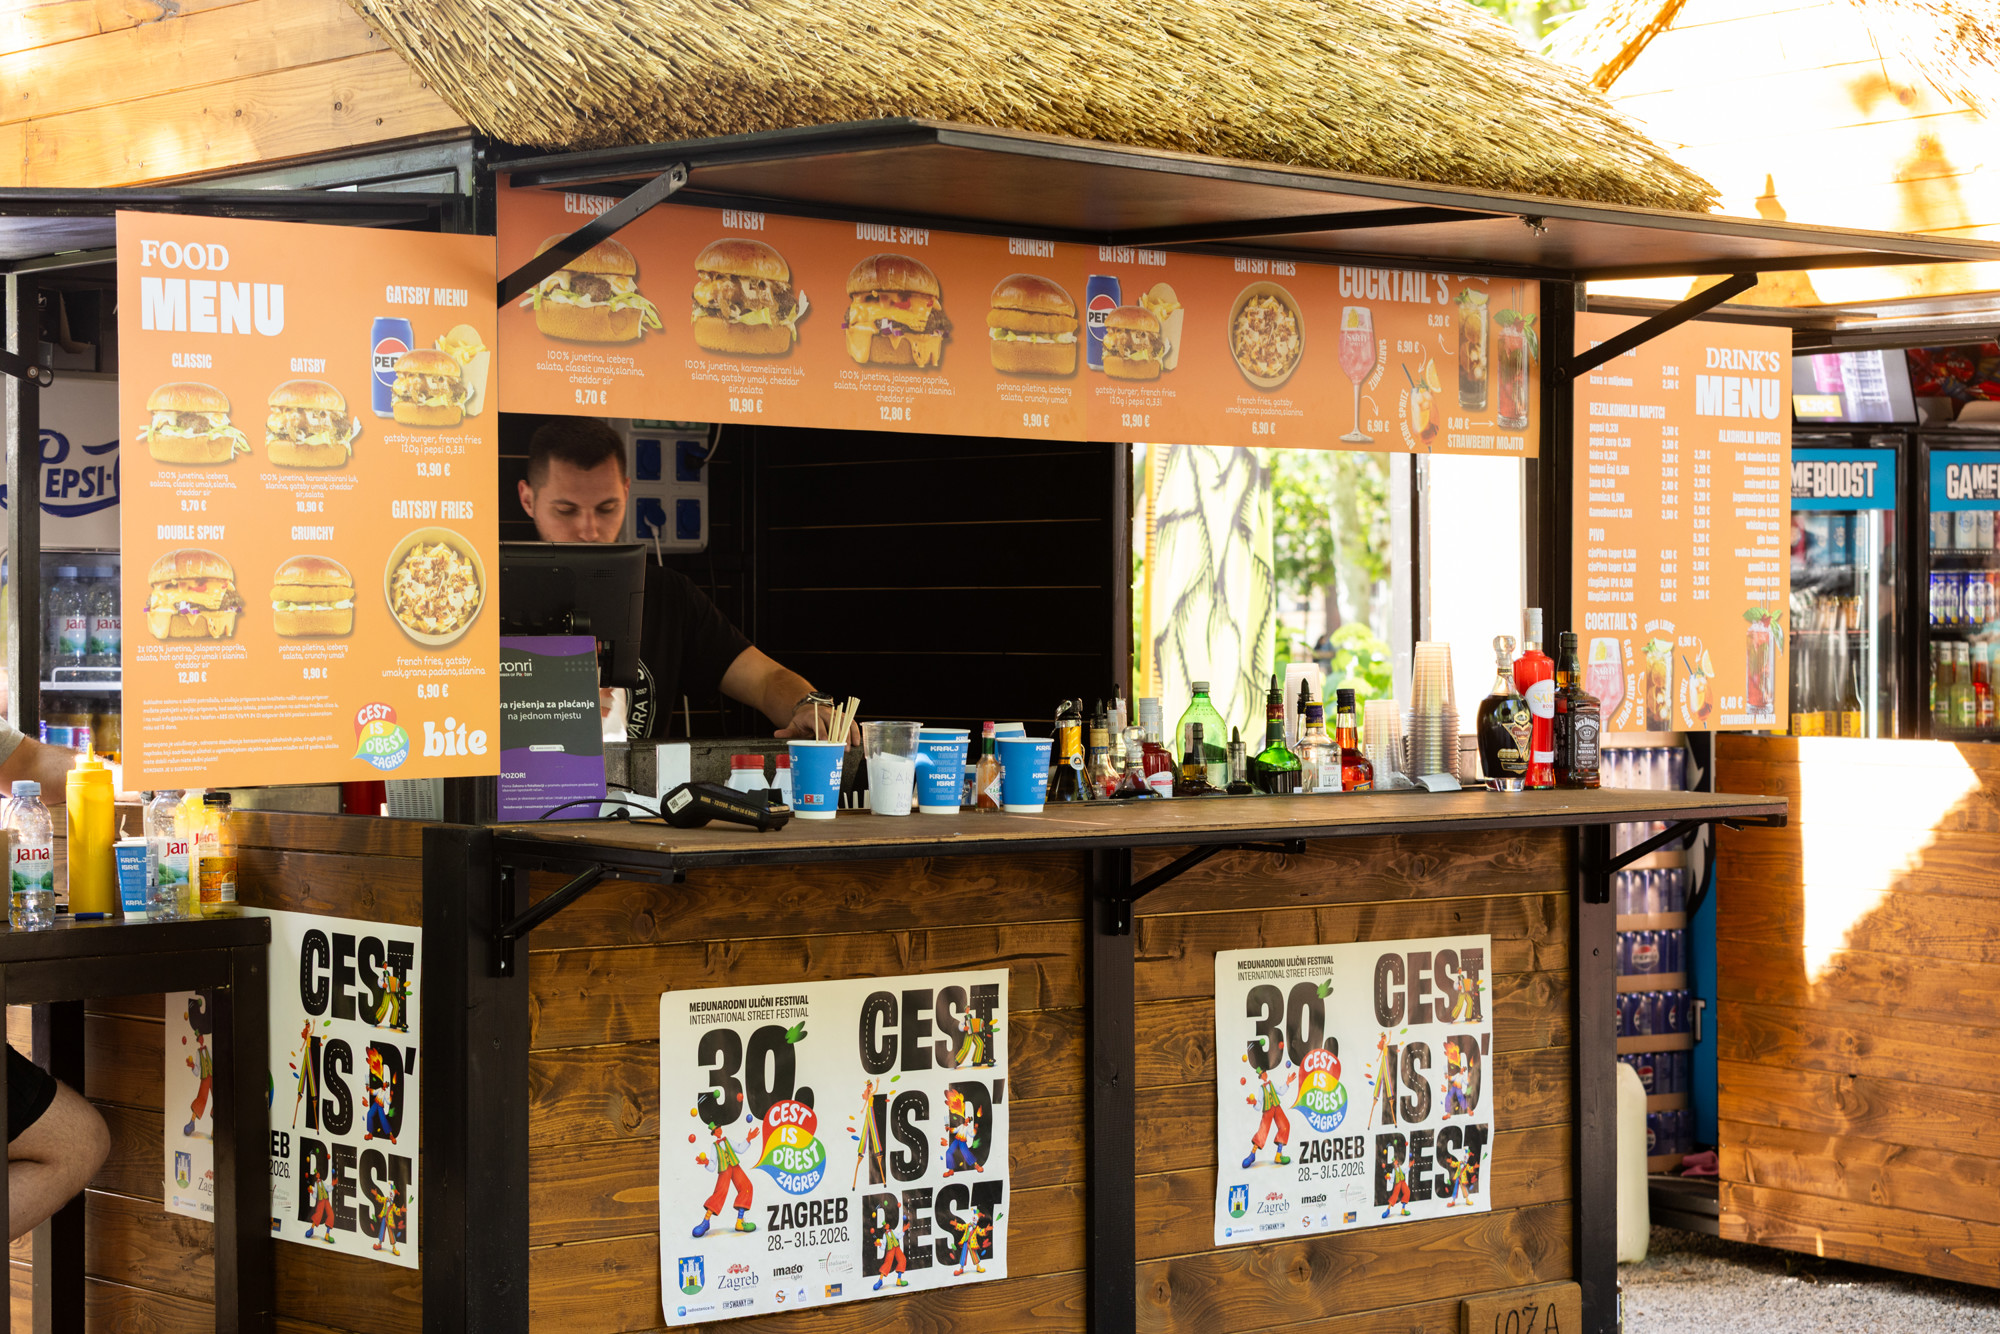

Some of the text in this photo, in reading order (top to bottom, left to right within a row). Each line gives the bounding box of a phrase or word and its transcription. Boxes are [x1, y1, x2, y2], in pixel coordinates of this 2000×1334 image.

[722, 210, 765, 231] GATSBY
[856, 222, 930, 246] DOUBLE SPICY
[141, 240, 229, 271] FOOD
[1009, 237, 1055, 258] CRUNCHY
[1099, 246, 1166, 266] GATSBY MENU
[1234, 258, 1296, 276] GATSBY FRIES
[1339, 265, 1449, 305] COCKTAIL'S
[386, 286, 468, 307] GATSBY MENU
[141, 277, 284, 336] MENU
[1428, 315, 1449, 327] 6,20 €
[1397, 341, 1419, 353] 6,90 €
[172, 353, 212, 368] CLASSIC
[291, 358, 326, 373] GATSBY
[536, 361, 563, 372] salata,
[565, 363, 591, 373] classic
[547, 351, 634, 367] 100% junetina, iceberg
[685, 360, 805, 376] 100% junetina, karamelizirani luk,
[1706, 347, 1780, 372] DRINK'S
[569, 375, 612, 384] cheddar sir
[691, 372, 799, 386] slanina, gatsby umak, cheddar
[1368, 366, 1384, 391] SPRITZ
[576, 389, 607, 405] 9,70 €
[729, 398, 762, 414] 10,90 €
[1399, 389, 1409, 418] SPRITZ
[1696, 375, 1780, 420] MENU
[905, 408, 911, 420] €
[1590, 403, 1665, 419] BEZALKOHOLNI NAPITCI
[1023, 413, 1049, 428] 9,90 €
[1121, 414, 1150, 428] 13,90 €
[1252, 422, 1275, 435] 6,90 €
[1367, 420, 1389, 432] 6,90 €
[1465, 418, 1469, 430] €
[384, 433, 482, 445] gatsby burger, french fries
[1448, 434, 1524, 451] STRAWBERRY MOJITO
[1719, 430, 1780, 445] ALKOHOLNI NAPITCI
[401, 444, 419, 455] 120g
[424, 444, 444, 455] pepsi
[417, 463, 450, 477] 13,90 €
[1791, 462, 1877, 498] MEBOOST
[1946, 464, 2000, 500] GAME
[182, 500, 206, 511] 9,70 €
[296, 502, 323, 513] 10,90 €
[392, 500, 473, 519] GATSBY FRIES
[158, 525, 225, 539] DOUBLE SPICY
[292, 526, 334, 540] CRUNCHY
[1589, 528, 1604, 541] PIVO
[1585, 612, 1637, 630] COCKTAIL'S
[303, 668, 327, 679] 9,90 €
[418, 684, 448, 698] 6,90 €
[510, 701, 544, 710] rješenja
[559, 700, 594, 709] plaćanje
[358, 704, 391, 726] CEST
[520, 712, 551, 721] jednom
[554, 712, 581, 721] mjestu
[370, 722, 384, 735] IS
[423, 717, 487, 756] bite
[365, 730, 405, 754] D'BEST
[372, 749, 407, 769] ZAGREB
[1238, 955, 1334, 969] MEĐUNARODNI ULIČNI FESTIVAL
[300, 929, 414, 1026] CEST
[1238, 966, 1334, 981] INTERNATIONAL STREET FESTIVAL
[1374, 948, 1484, 1027] CEST
[689, 995, 809, 1013] MEĐUNARODNI ULIČNI FESTIVAL
[689, 1007, 809, 1025] INTERNATIONAL STREET FESTIVAL
[859, 984, 999, 1074] CEST
[1246, 982, 1339, 1071] 30.
[1303, 1050, 1337, 1072] CEST
[698, 1025, 814, 1126] 30.
[1313, 1074, 1326, 1088] IS
[1382, 1033, 1490, 1125] IS D'
[305, 1036, 416, 1140] IS D'
[1306, 1088, 1343, 1112] D'BEST
[768, 1103, 812, 1128] CEST
[1309, 1112, 1343, 1130] ZAGREB
[781, 1128, 797, 1144] IS
[868, 1078, 1005, 1185] IS D'
[773, 1144, 820, 1172] D'BEST
[1299, 1136, 1365, 1164] ZAGREB
[1374, 1123, 1488, 1207] BEST
[298, 1136, 412, 1244] BEST
[776, 1170, 820, 1193] ZAGREB
[1257, 1200, 1290, 1215] Zagreb
[1302, 1194, 1326, 1205] imago
[767, 1197, 848, 1231] ZAGREB
[862, 1180, 1003, 1277] BEST
[773, 1264, 802, 1277] imago
[718, 1272, 759, 1291] Zagreb
